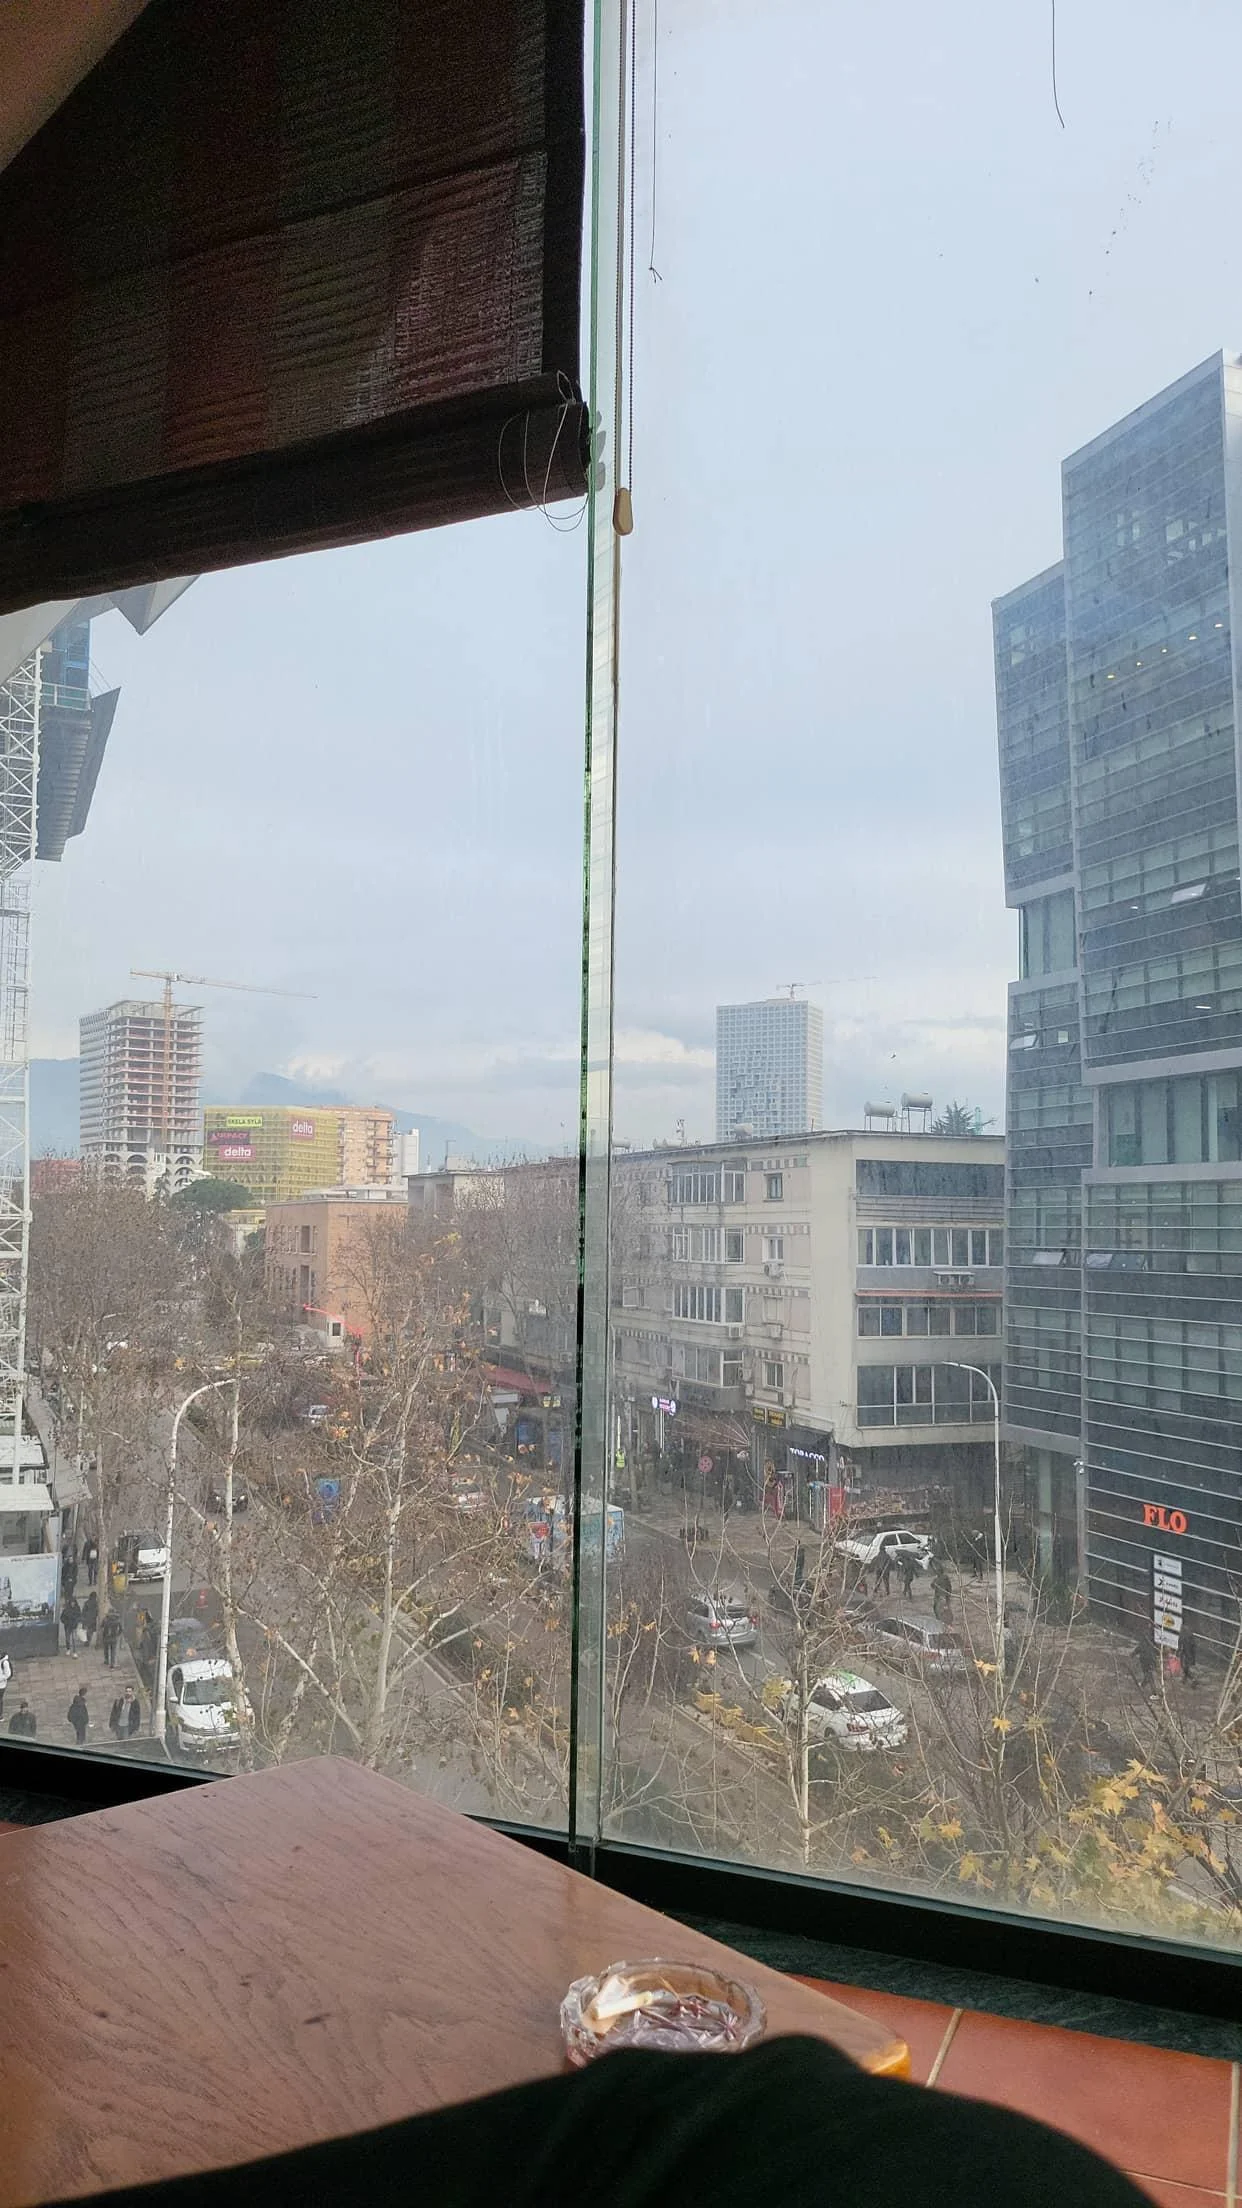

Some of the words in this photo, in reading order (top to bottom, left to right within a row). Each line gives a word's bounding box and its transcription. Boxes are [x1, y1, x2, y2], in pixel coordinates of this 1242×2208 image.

[224, 1146, 251, 1156] delta
[789, 1447, 825, 1461] TOBACCO
[1143, 1504, 1187, 1533] FLO
